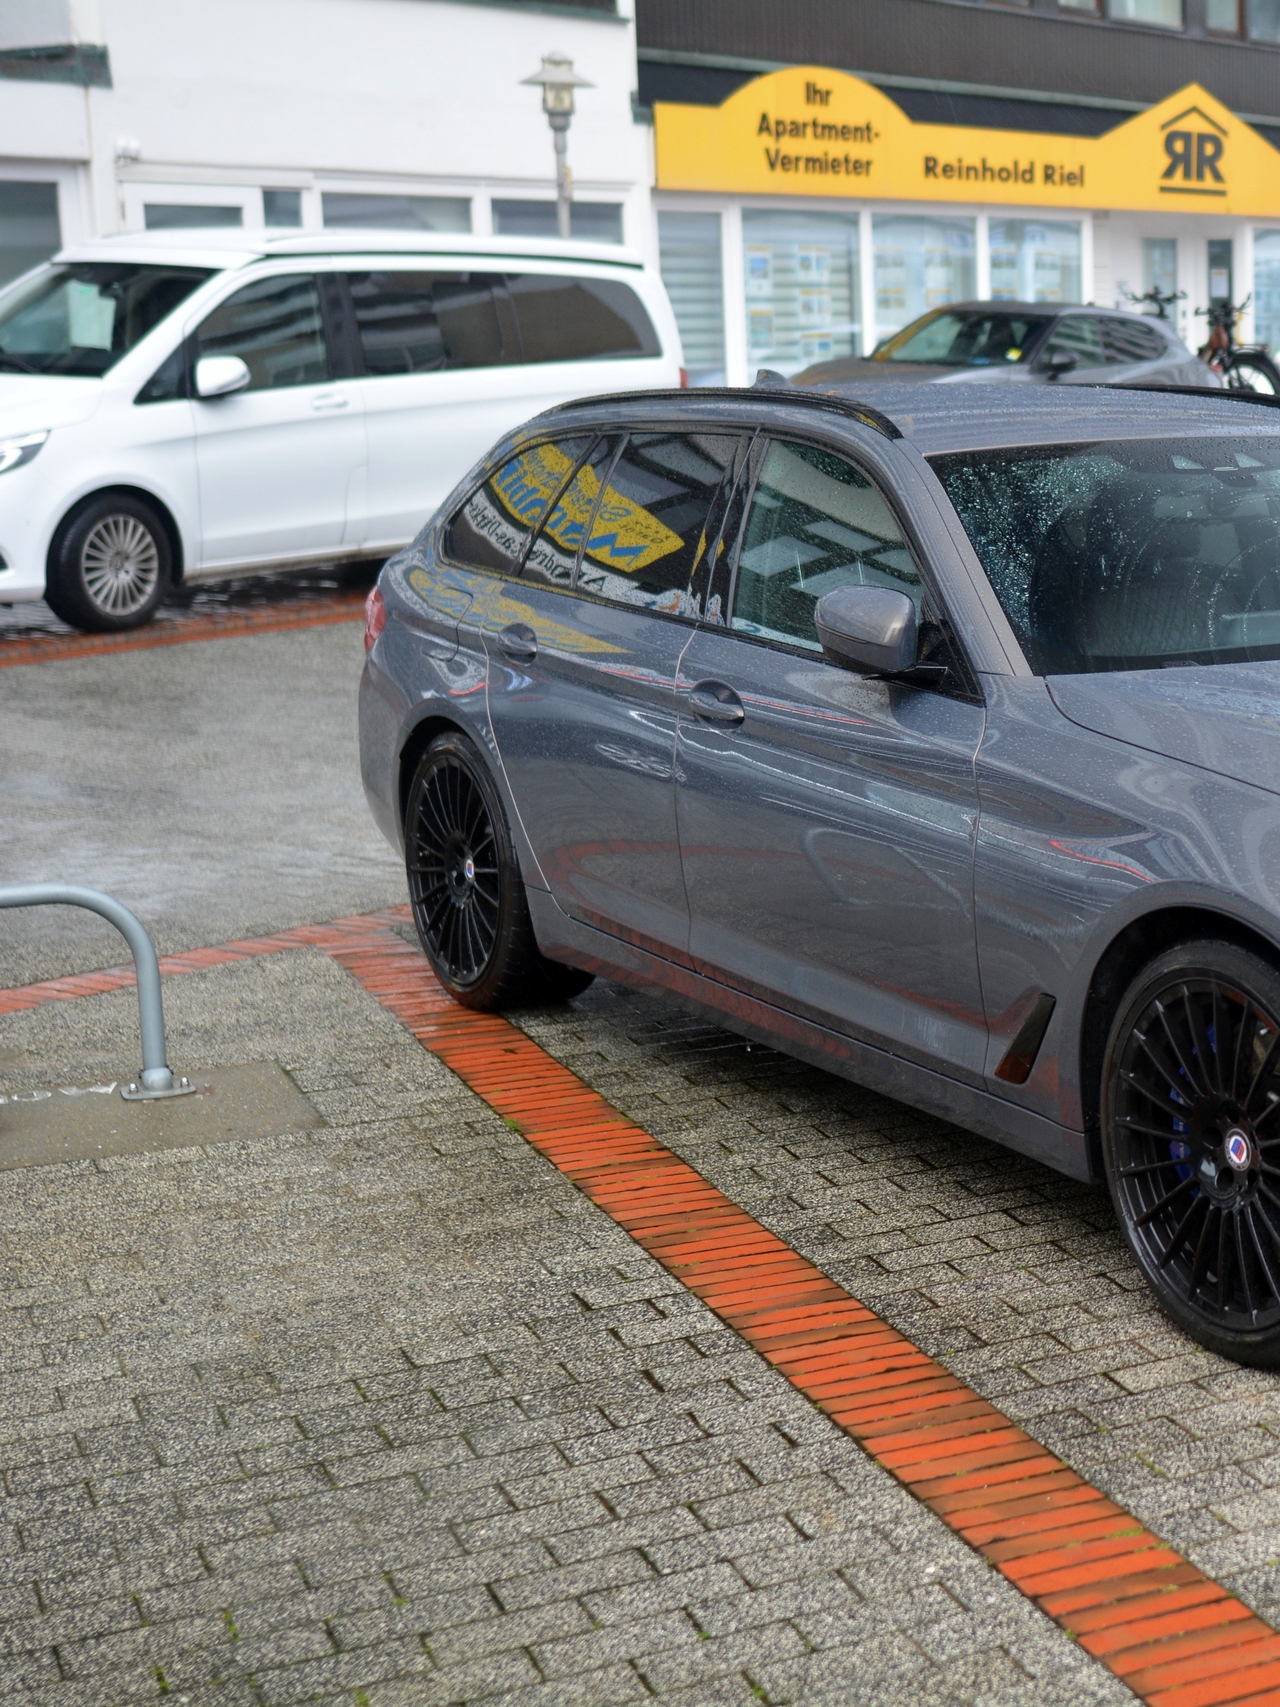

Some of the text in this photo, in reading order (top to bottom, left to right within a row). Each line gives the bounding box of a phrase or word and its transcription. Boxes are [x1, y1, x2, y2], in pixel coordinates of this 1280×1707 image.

[805, 81, 833, 106] Ihr
[758, 112, 880, 143] Apartment-
[765, 147, 873, 176] Vermieter
[924, 155, 1084, 188] Reinhold Riel
